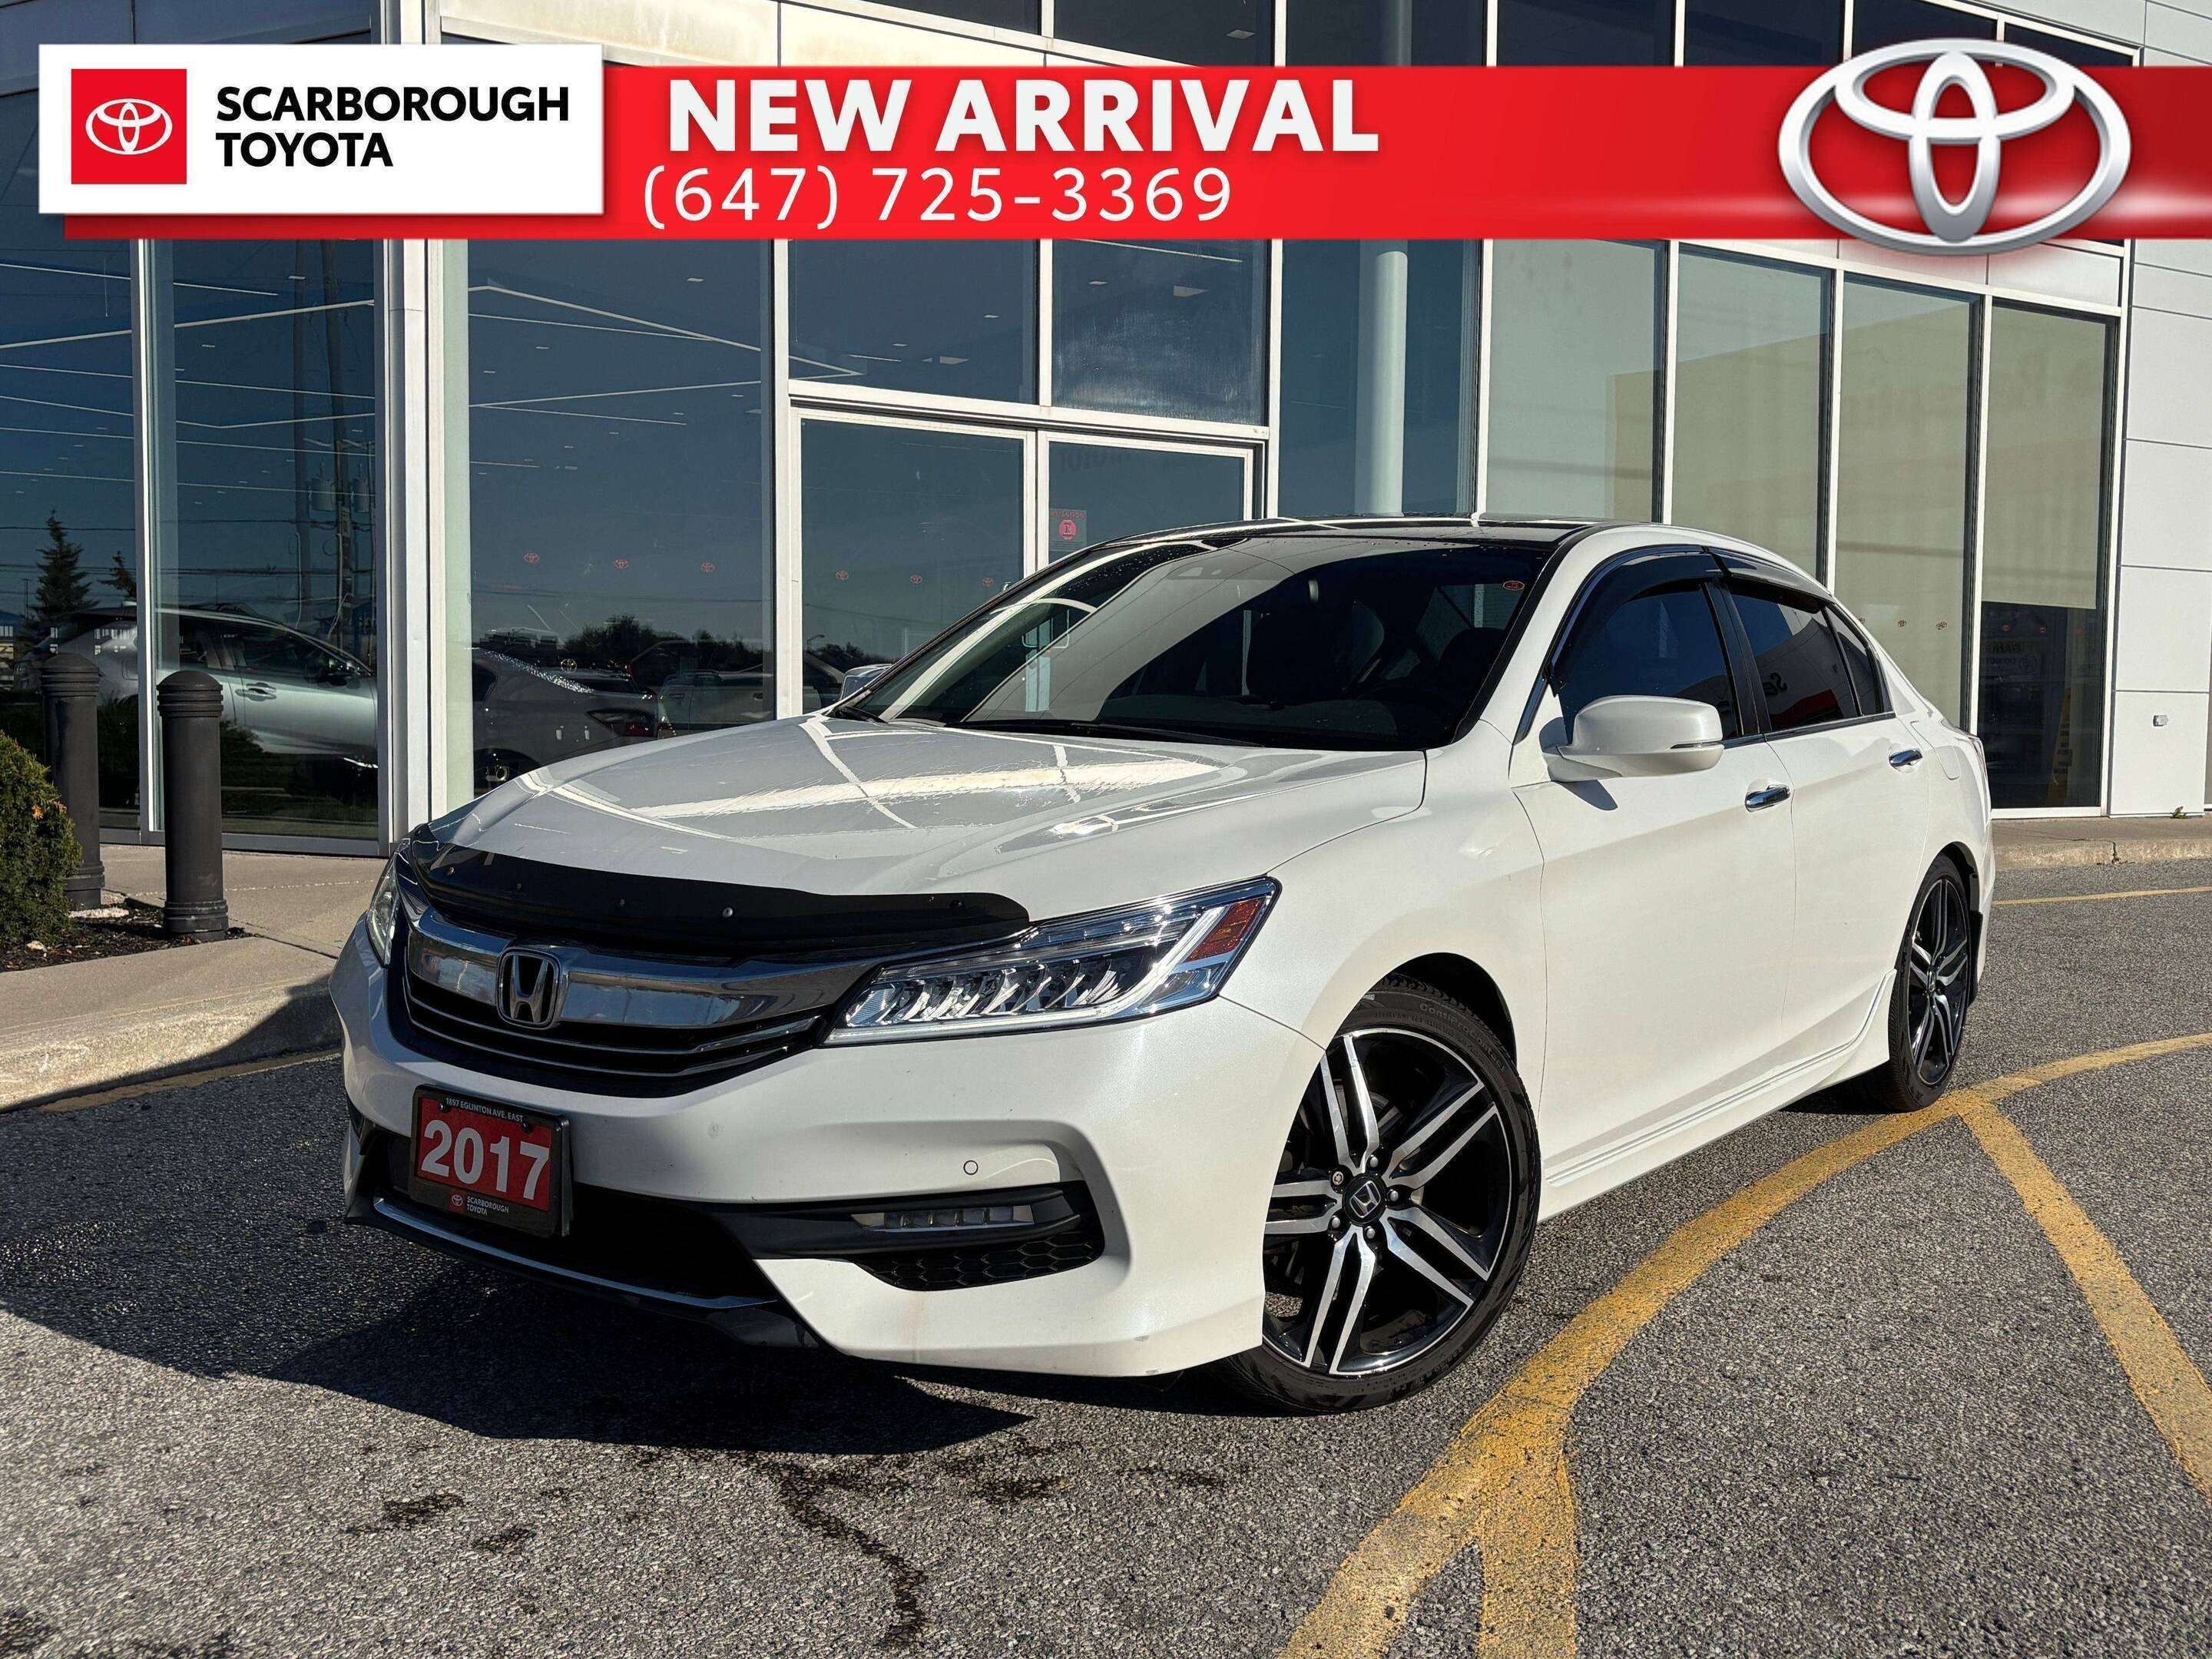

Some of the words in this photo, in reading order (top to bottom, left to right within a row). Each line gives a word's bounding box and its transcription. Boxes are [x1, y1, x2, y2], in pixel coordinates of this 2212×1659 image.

[445, 1097, 460, 1108] 1897
[460, 1101, 492, 1116] EGLINTON
[507, 1112, 523, 1122] EAST
[421, 1119, 550, 1200] 2017
[467, 1196, 509, 1214] SCARBOROUGH
[467, 1204, 488, 1215] TOYOTA
